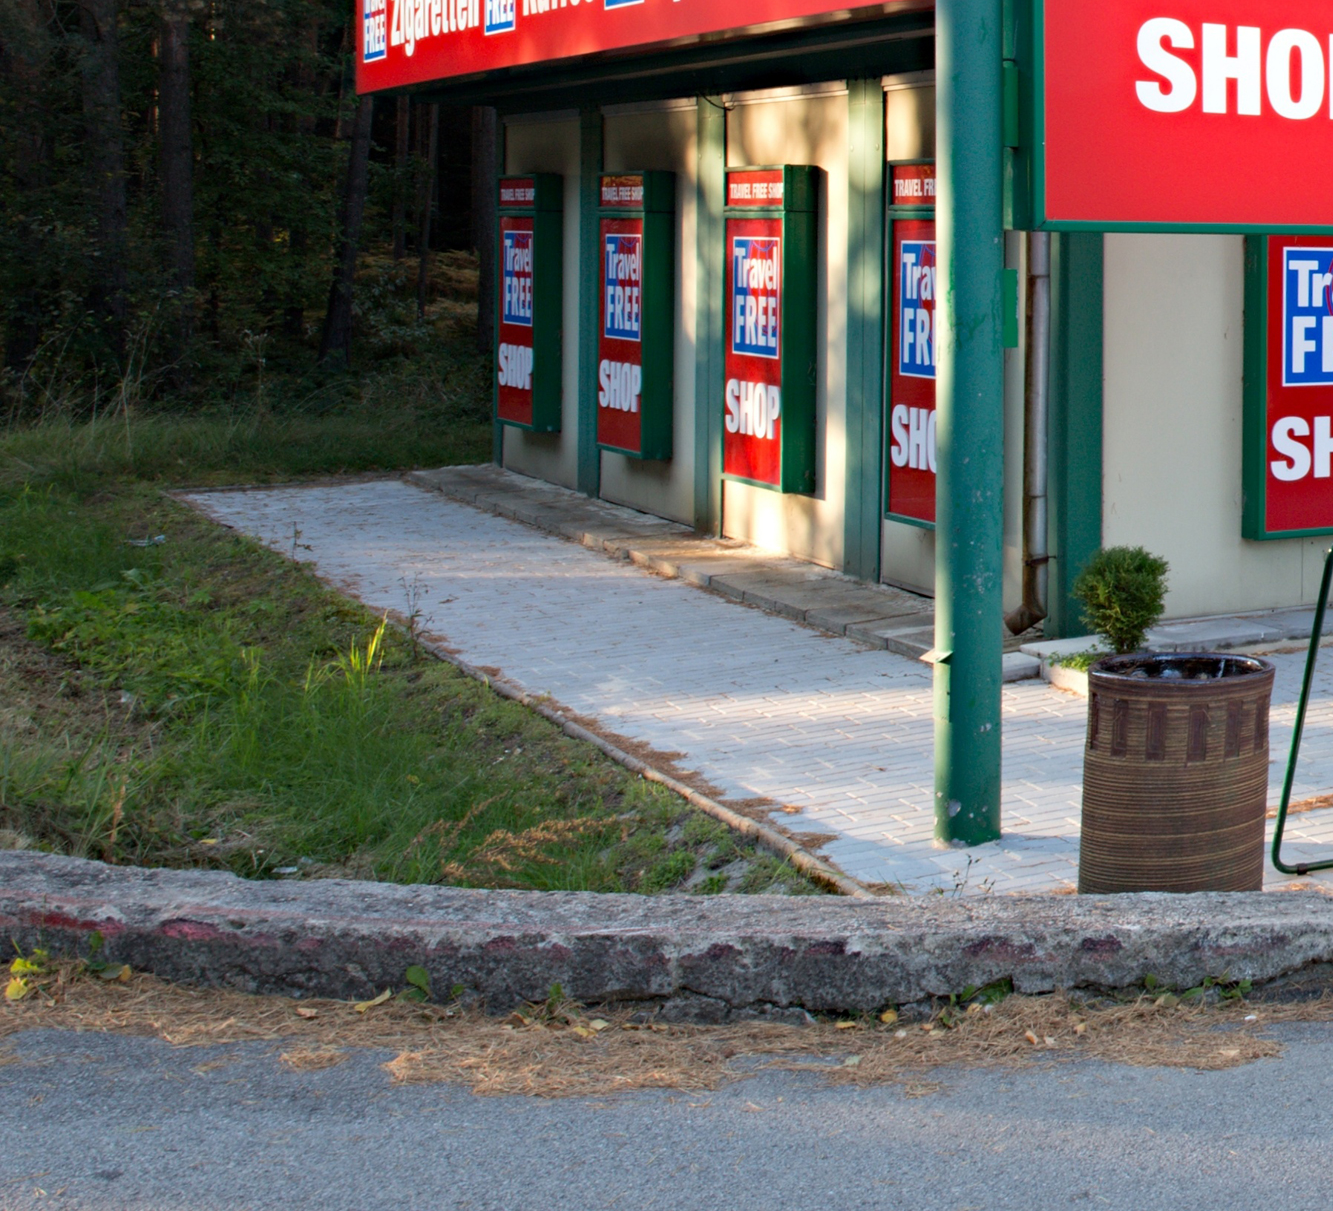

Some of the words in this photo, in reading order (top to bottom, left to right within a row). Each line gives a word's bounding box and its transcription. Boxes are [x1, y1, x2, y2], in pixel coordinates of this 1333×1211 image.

[364, 14, 385, 54] FREE
[894, 178, 922, 196] TRAVEL
[923, 178, 936, 196] FR
[504, 239, 532, 273] Travel
[606, 242, 640, 281] Travel
[734, 245, 778, 290] Travel
[903, 253, 936, 300] Tra
[505, 276, 531, 317] FREE
[607, 286, 639, 332] FREE
[734, 295, 778, 349] FREE
[903, 307, 936, 366] FR
[498, 342, 533, 391] SHOP
[599, 359, 642, 413] SHOP
[725, 378, 781, 439] SHOP
[891, 404, 937, 474] SHO
